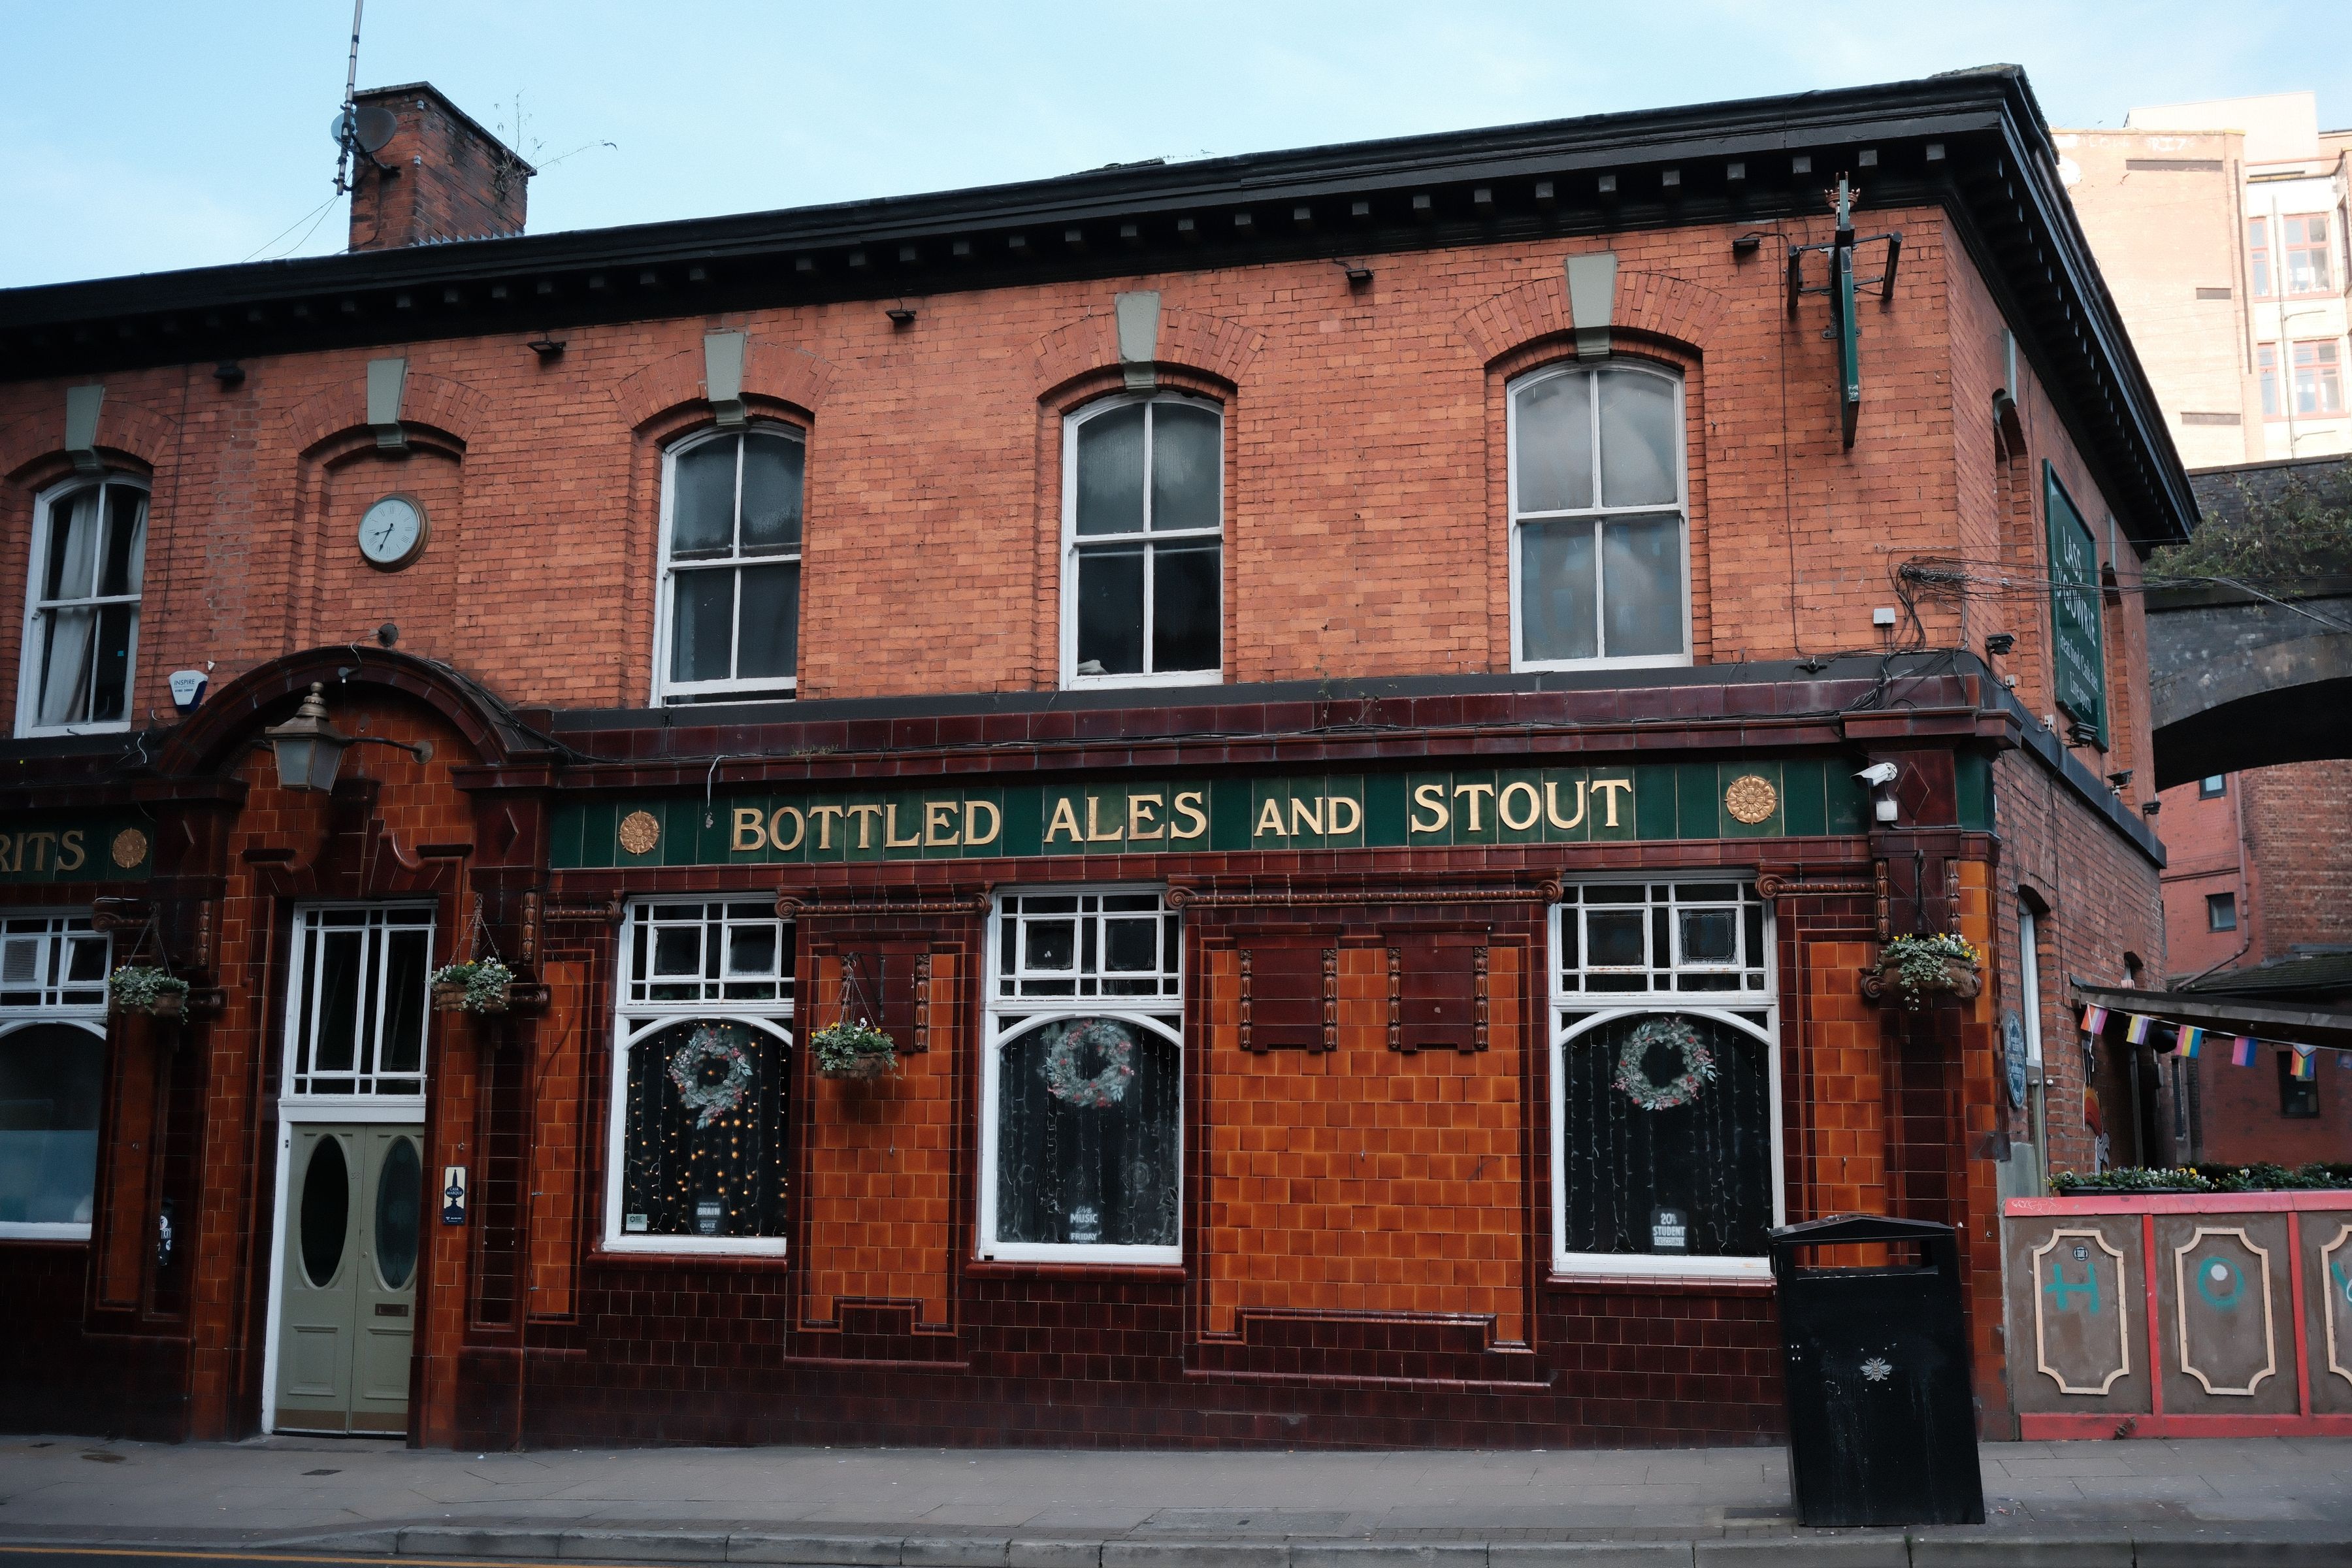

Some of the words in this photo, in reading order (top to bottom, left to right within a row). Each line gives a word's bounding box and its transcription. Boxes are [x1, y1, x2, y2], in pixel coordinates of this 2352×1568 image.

[2063, 525, 2082, 583] LASS
[2081, 655, 2091, 684] Cask
[2069, 670, 2079, 700] Live
[2080, 687, 2092, 714] sports
[732, 800, 1001, 851] BOTTLED
[1043, 792, 1207, 843] ALES
[1254, 796, 1361, 837] AND
[1411, 779, 1632, 833] STOUT
[1070, 1214, 1098, 1223] MUSIC
[1652, 1226, 1686, 1236] STUDENT
[1660, 1213, 1677, 1224] 20%
[2044, 1263, 2100, 1315] H
